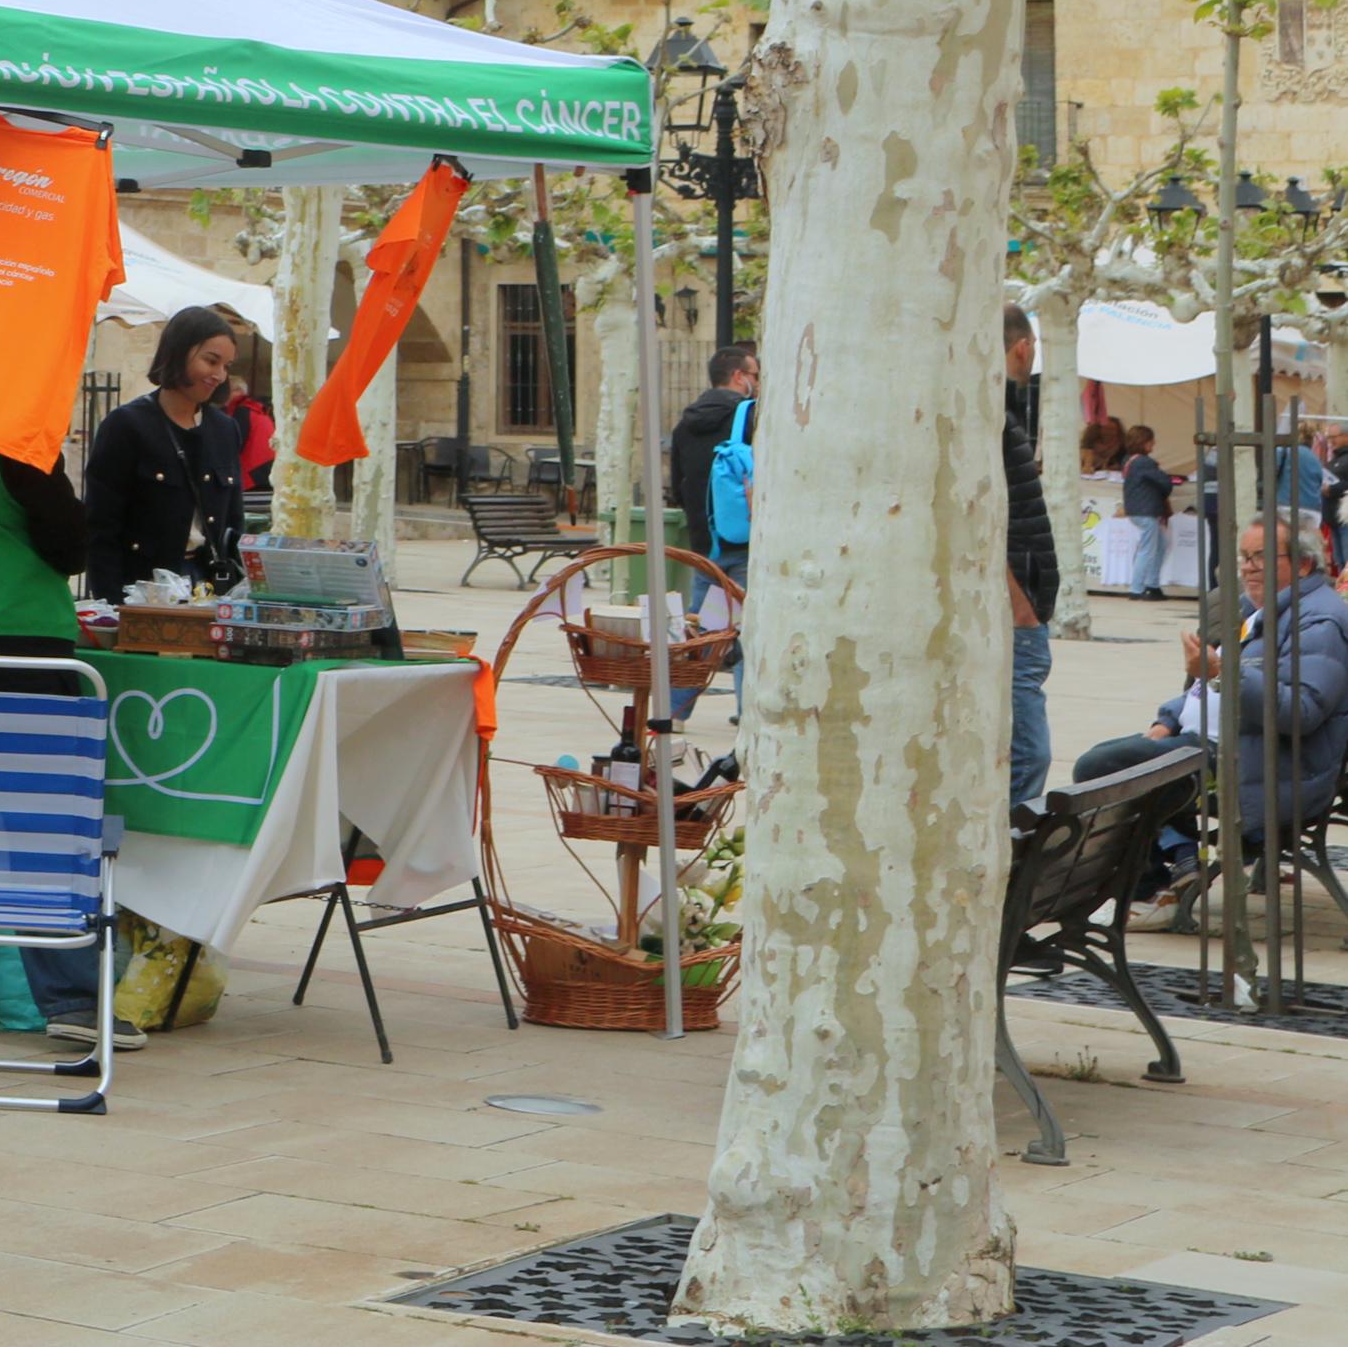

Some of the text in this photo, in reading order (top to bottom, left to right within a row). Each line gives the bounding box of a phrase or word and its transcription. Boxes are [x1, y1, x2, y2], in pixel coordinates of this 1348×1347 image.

[318, 85, 478, 131] CONTRA
[471, 98, 524, 133] EL
[516, 89, 642, 142] CÁNCER
[18, 186, 66, 204] COMERCIAL
[25, 207, 35, 219] y
[34, 209, 55, 222] gas
[6, 268, 35, 282] cáncer
[17, 261, 56, 277] española
